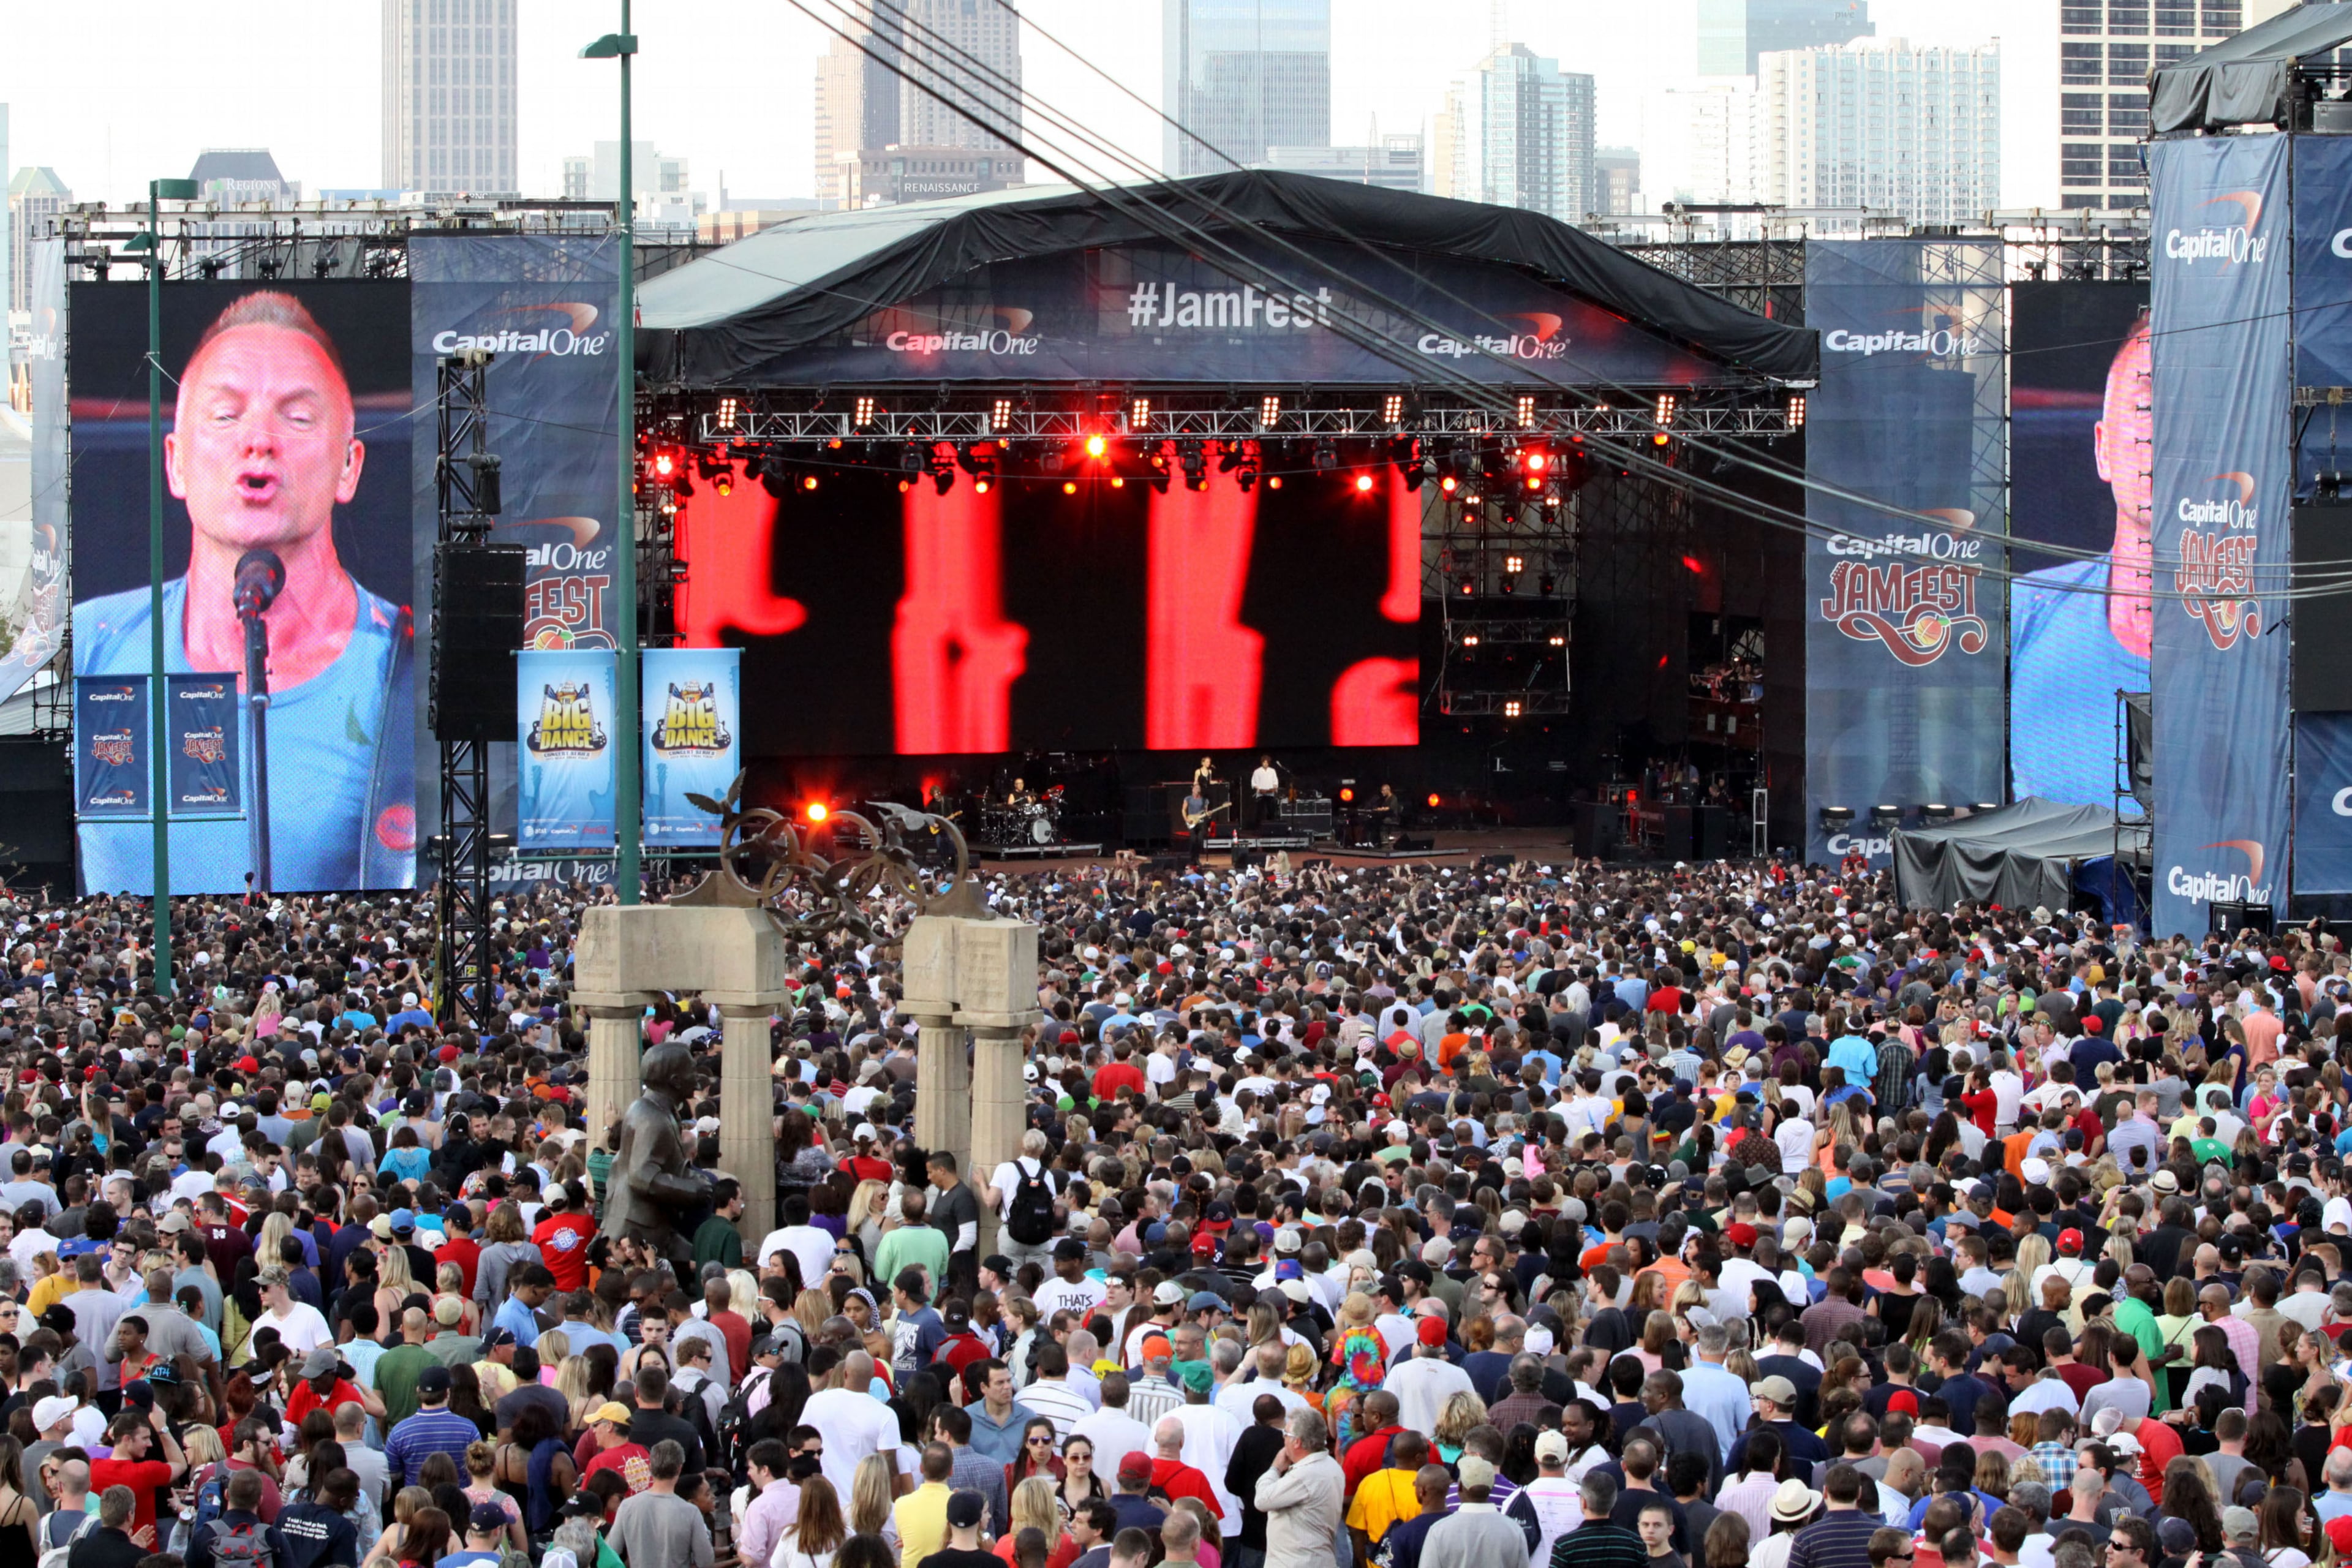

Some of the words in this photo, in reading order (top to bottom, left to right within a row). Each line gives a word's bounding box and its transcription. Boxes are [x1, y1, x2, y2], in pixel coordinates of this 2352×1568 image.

[1128, 282, 1332, 328] #JamFest
[542, 697, 592, 730] BIG
[666, 695, 716, 728] BIG
[540, 729, 596, 750] DANCE
[664, 728, 720, 748] DANCE
[1057, 1294, 1093, 1306] THATS
